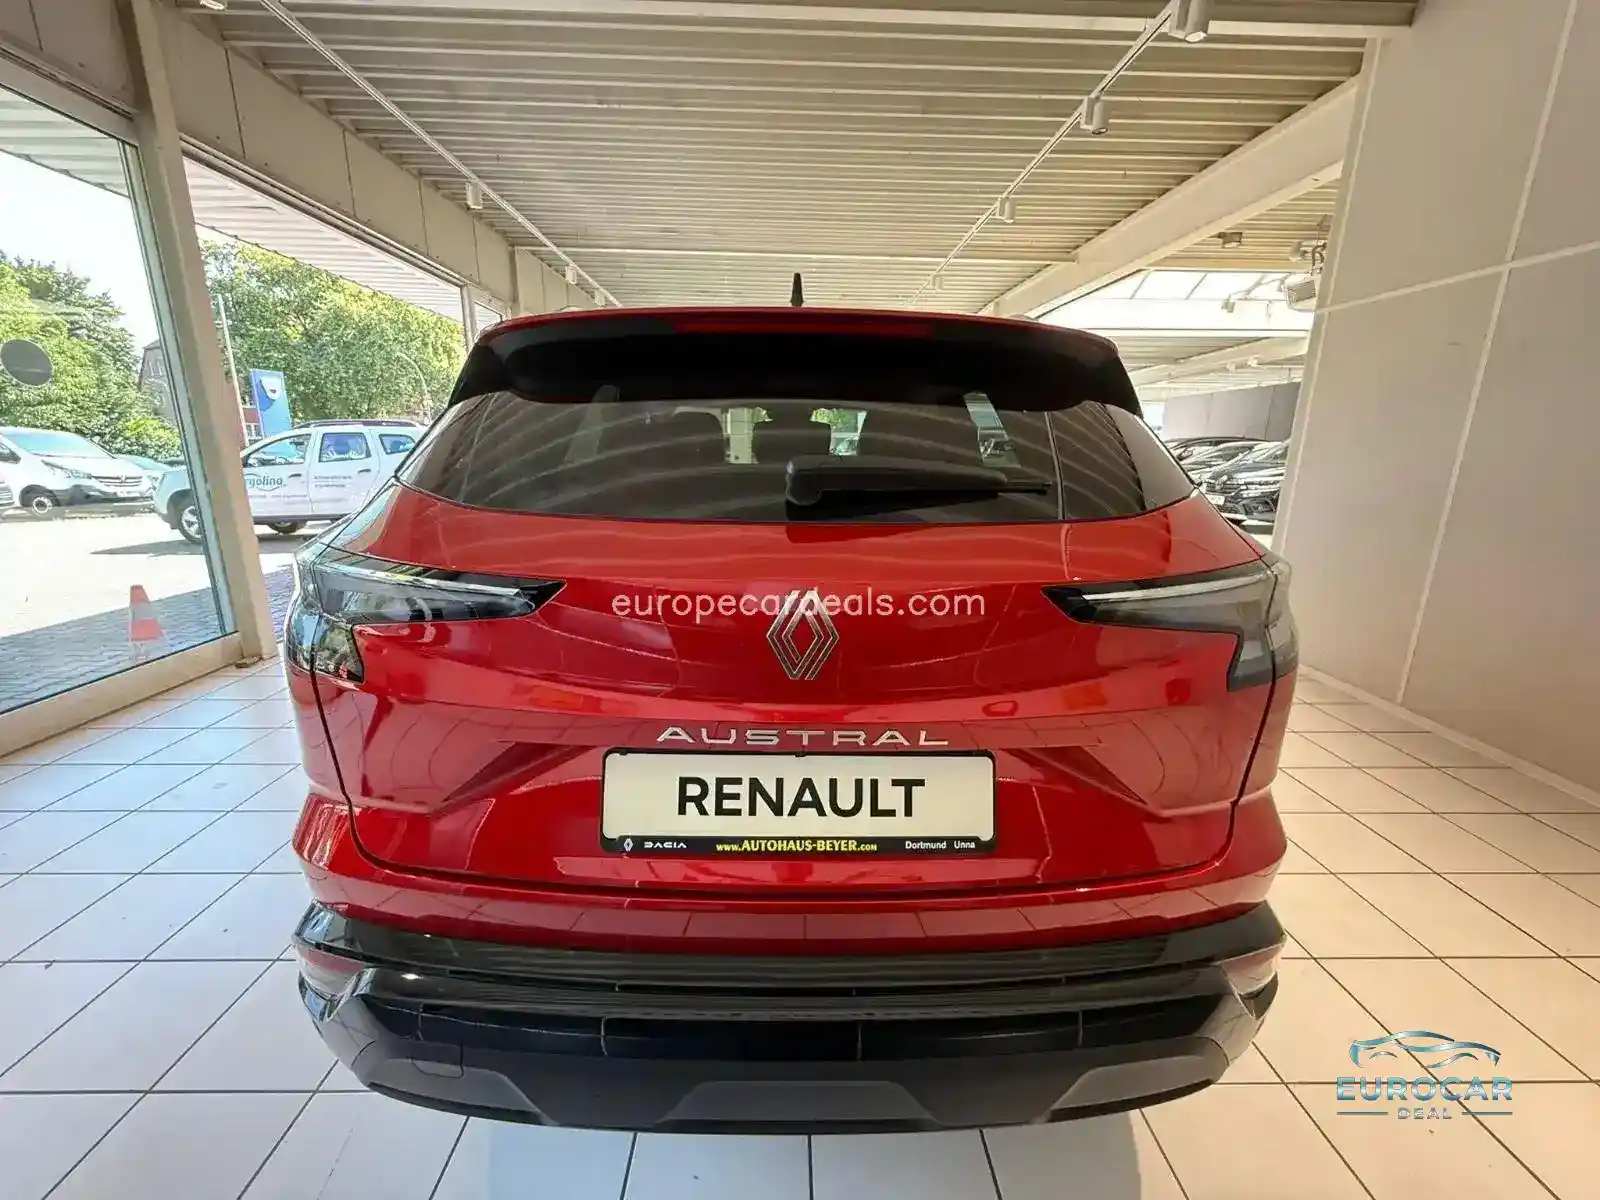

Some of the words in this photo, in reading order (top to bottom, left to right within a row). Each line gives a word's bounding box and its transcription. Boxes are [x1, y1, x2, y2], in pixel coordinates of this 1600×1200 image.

[656, 726, 949, 747] AUSTRAL
[677, 777, 926, 818] RENAULT
[644, 841, 687, 849] DACIA
[905, 840, 947, 850] Dortmund
[954, 840, 975, 849] Unna
